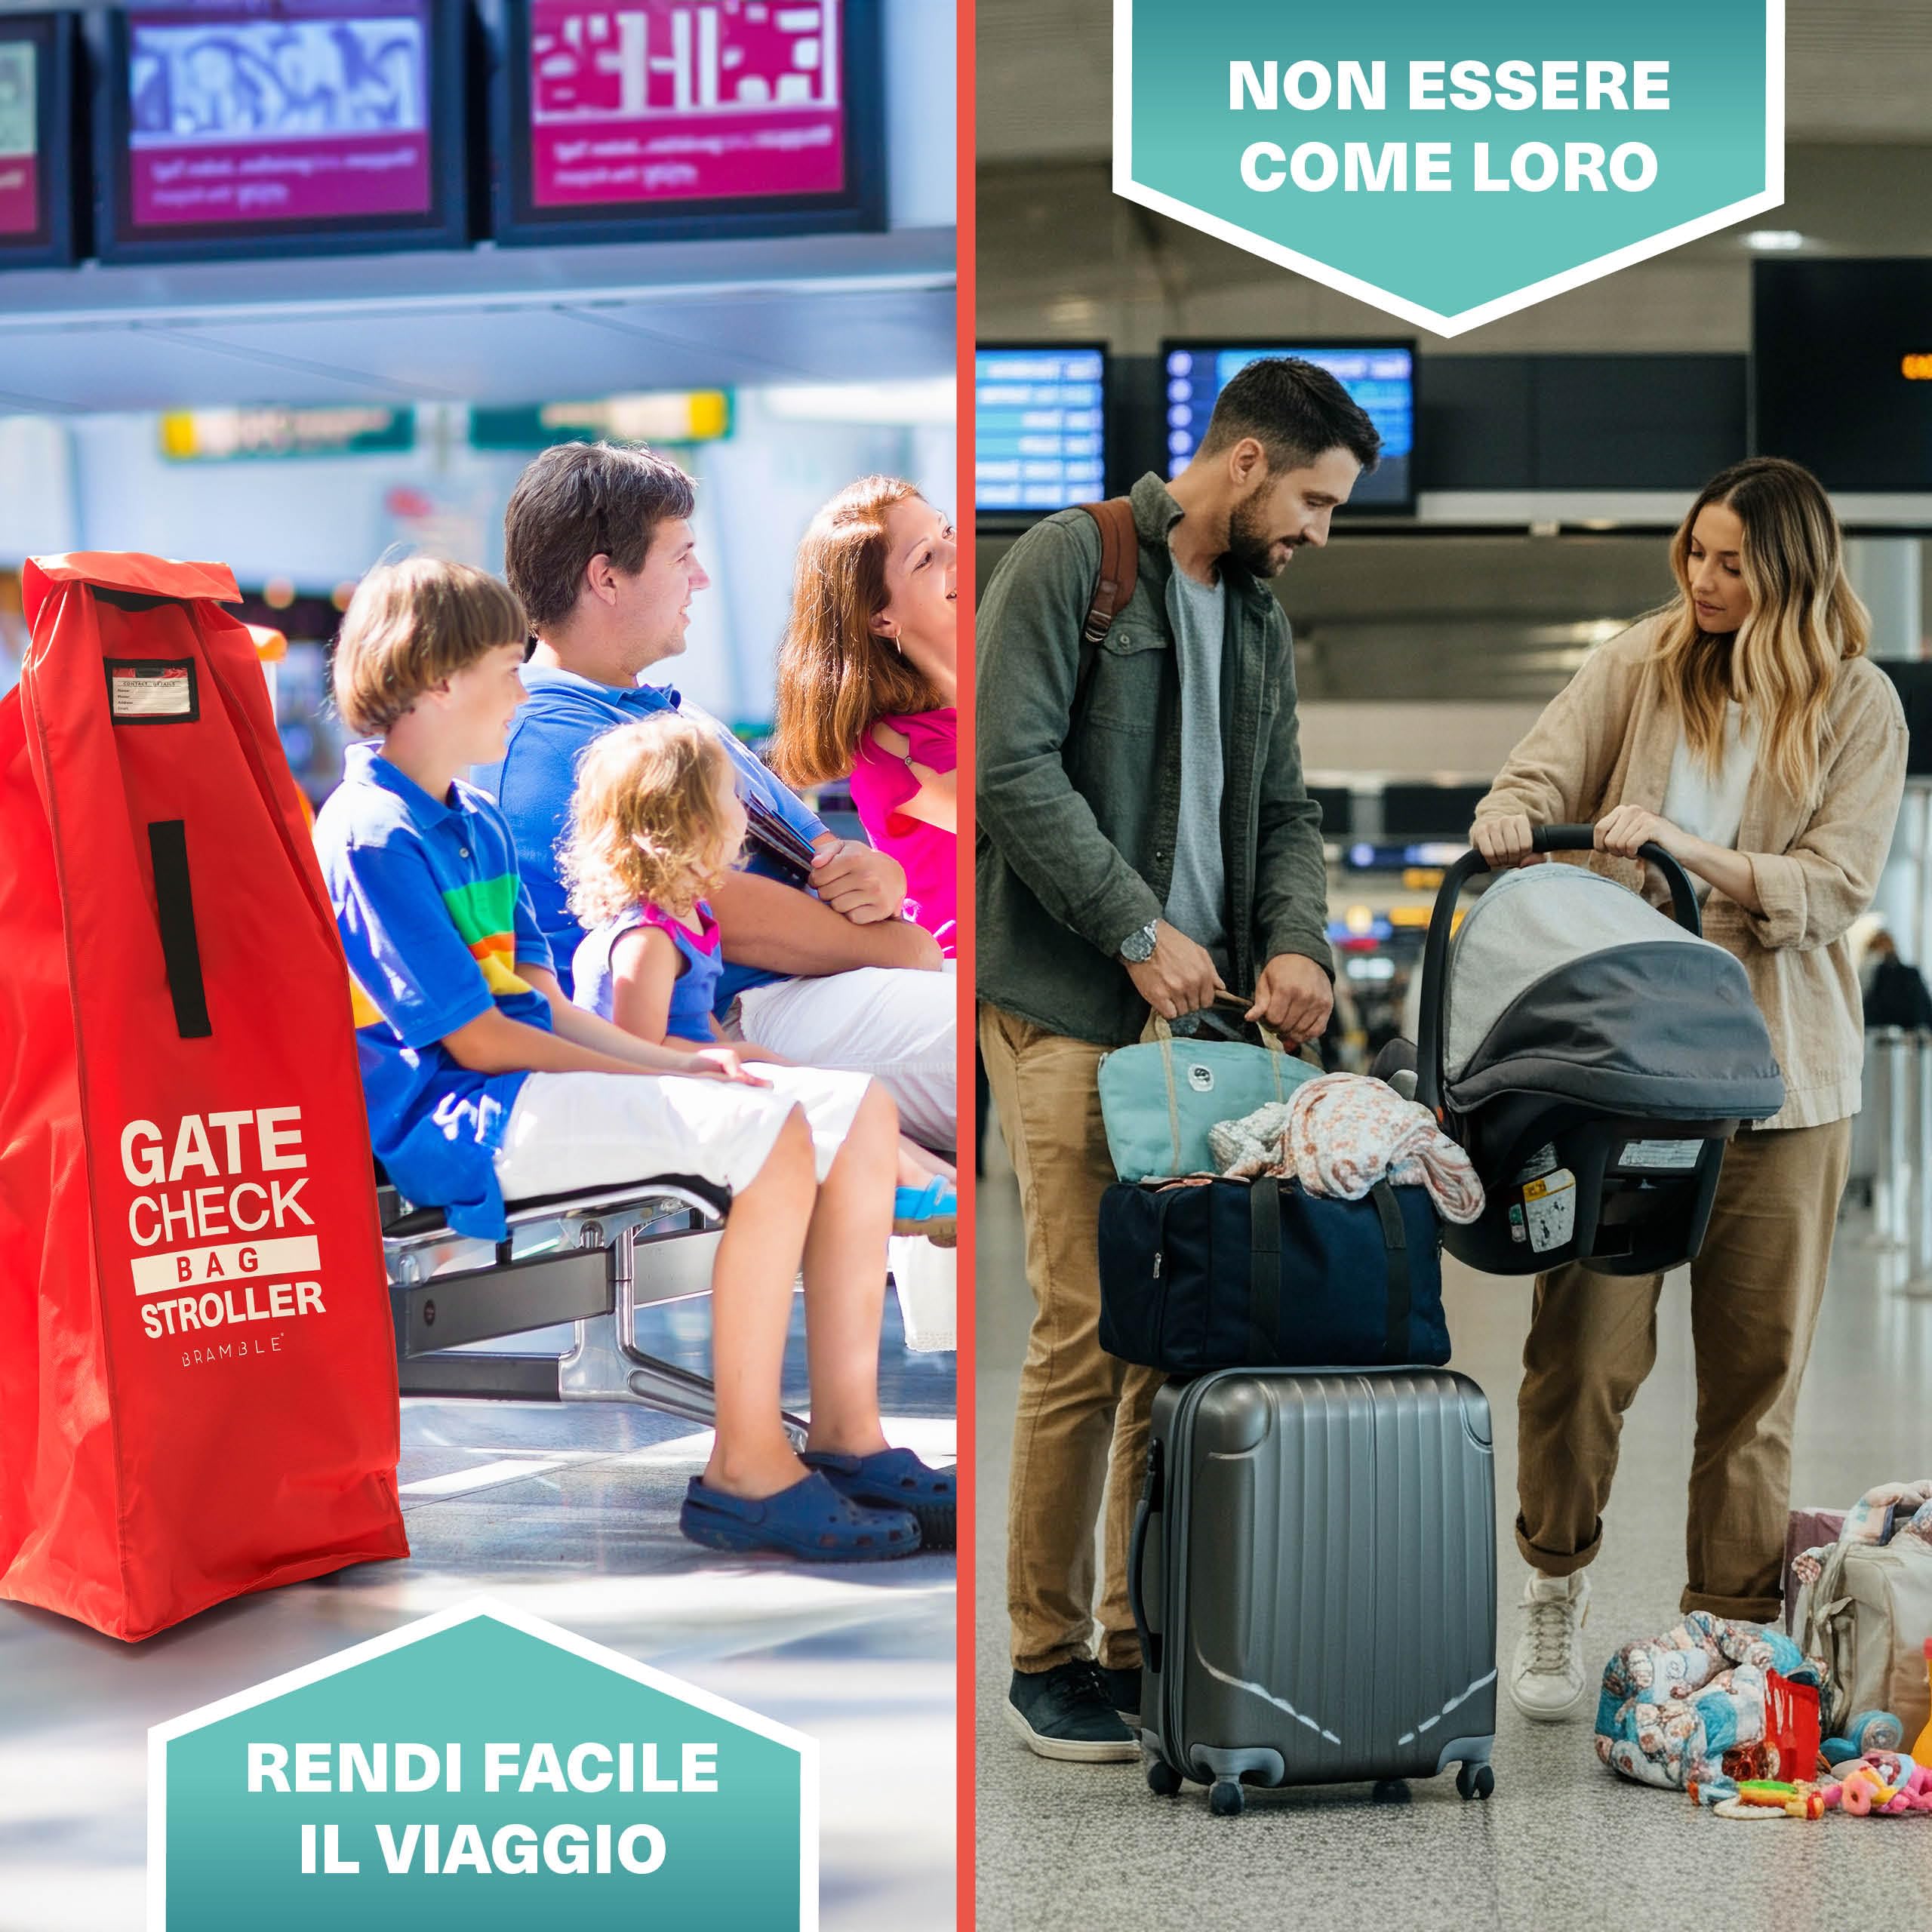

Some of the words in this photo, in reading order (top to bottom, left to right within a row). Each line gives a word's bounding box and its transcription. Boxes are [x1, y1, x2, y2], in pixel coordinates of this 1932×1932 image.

[121, 1106, 307, 1187] GATE
[128, 1177, 315, 1247] CHECK
[177, 1247, 259, 1282] BAG
[141, 1281, 327, 1339] STROLLER
